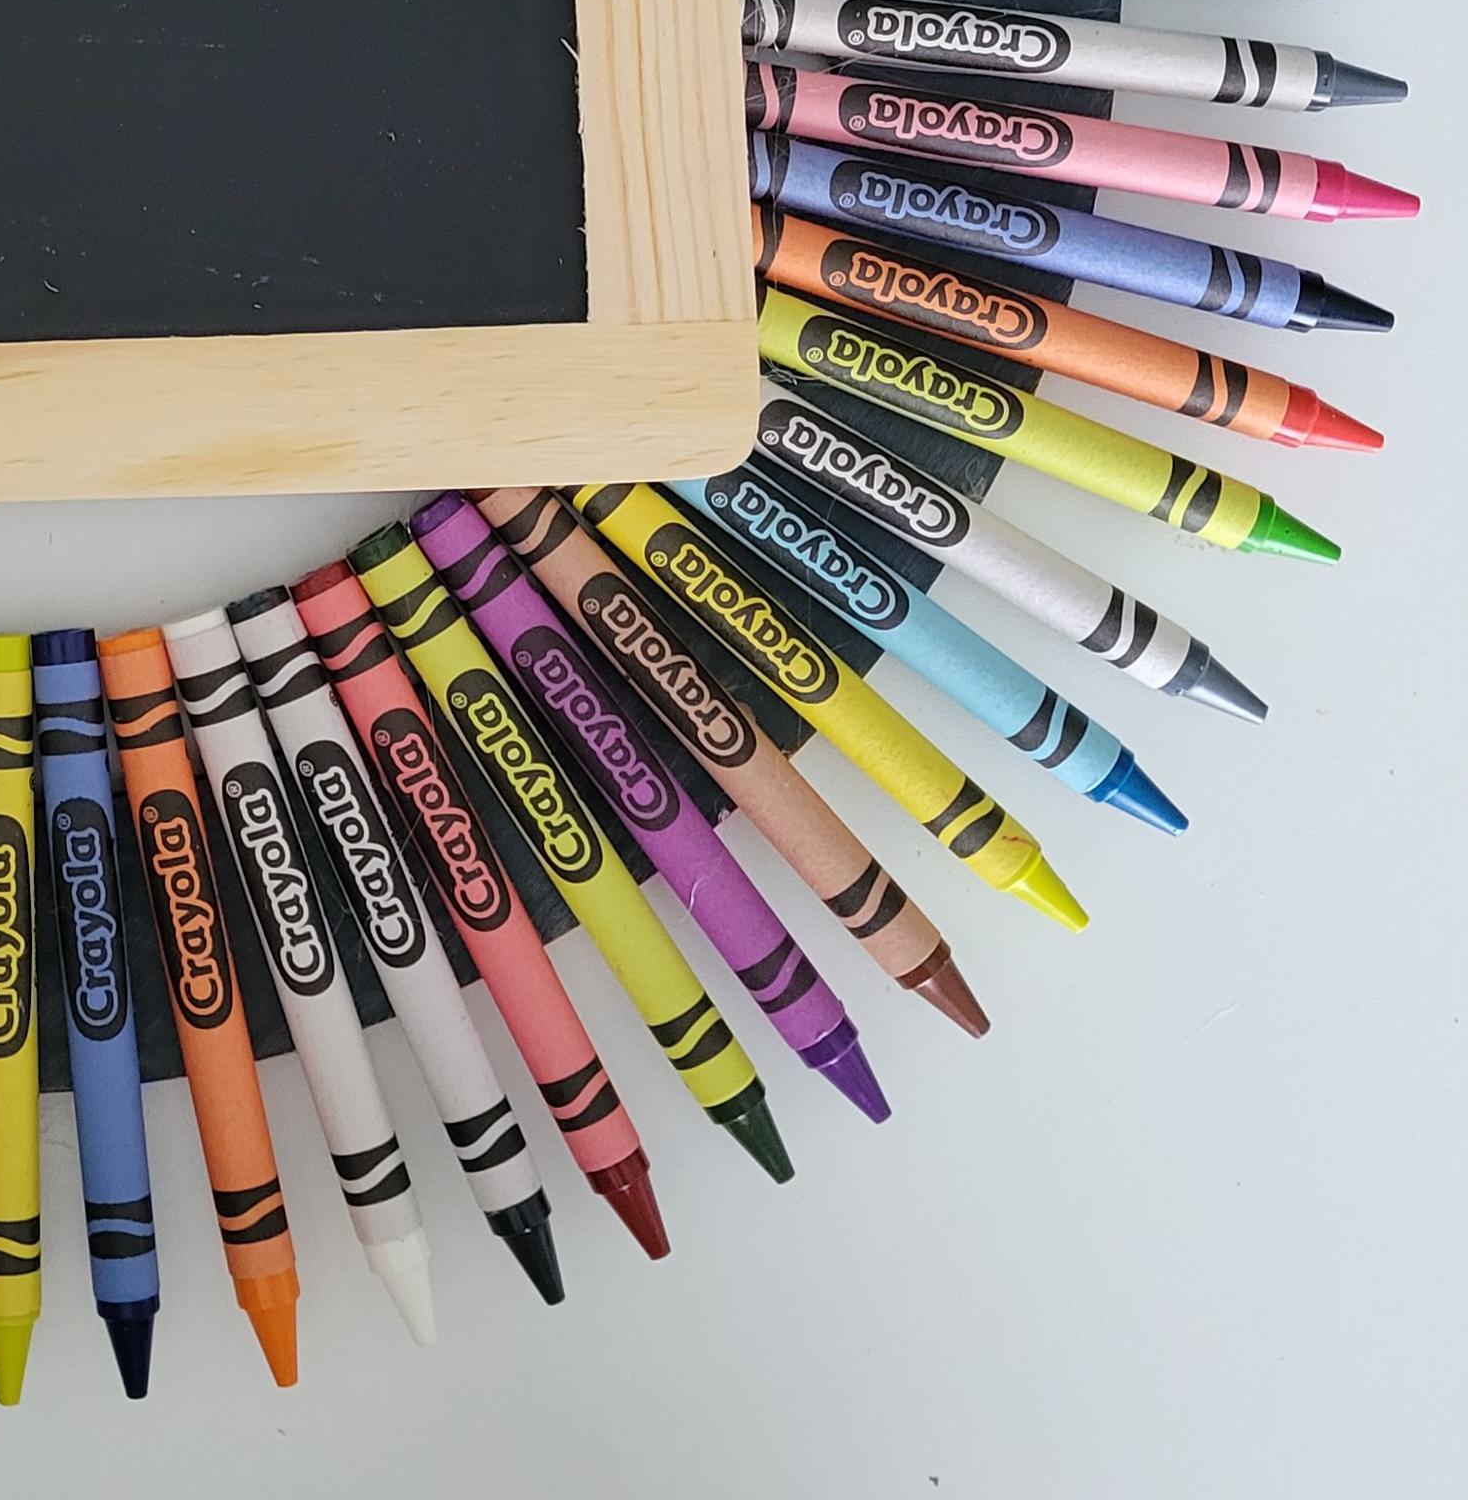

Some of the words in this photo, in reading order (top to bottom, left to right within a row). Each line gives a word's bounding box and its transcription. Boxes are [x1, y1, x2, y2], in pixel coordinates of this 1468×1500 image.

[868, 4, 1058, 67] Crayola
[869, 93, 1060, 159] Crayola
[860, 171, 1047, 251] Crayola
[850, 250, 1035, 342] Crayola
[827, 329, 1014, 432] Crayola
[730, 478, 896, 623] Crayola
[782, 415, 957, 540] Crayola
[599, 592, 747, 758] Crayola
[668, 542, 829, 694] Crayola
[466, 692, 593, 872] Crayola
[533, 648, 669, 821] Crayola
[238, 787, 327, 985] Crayola
[314, 765, 418, 957] Crayola
[387, 732, 501, 919] Crayola
[60, 825, 118, 1028] Crayola
[153, 816, 227, 1018] Crayola
